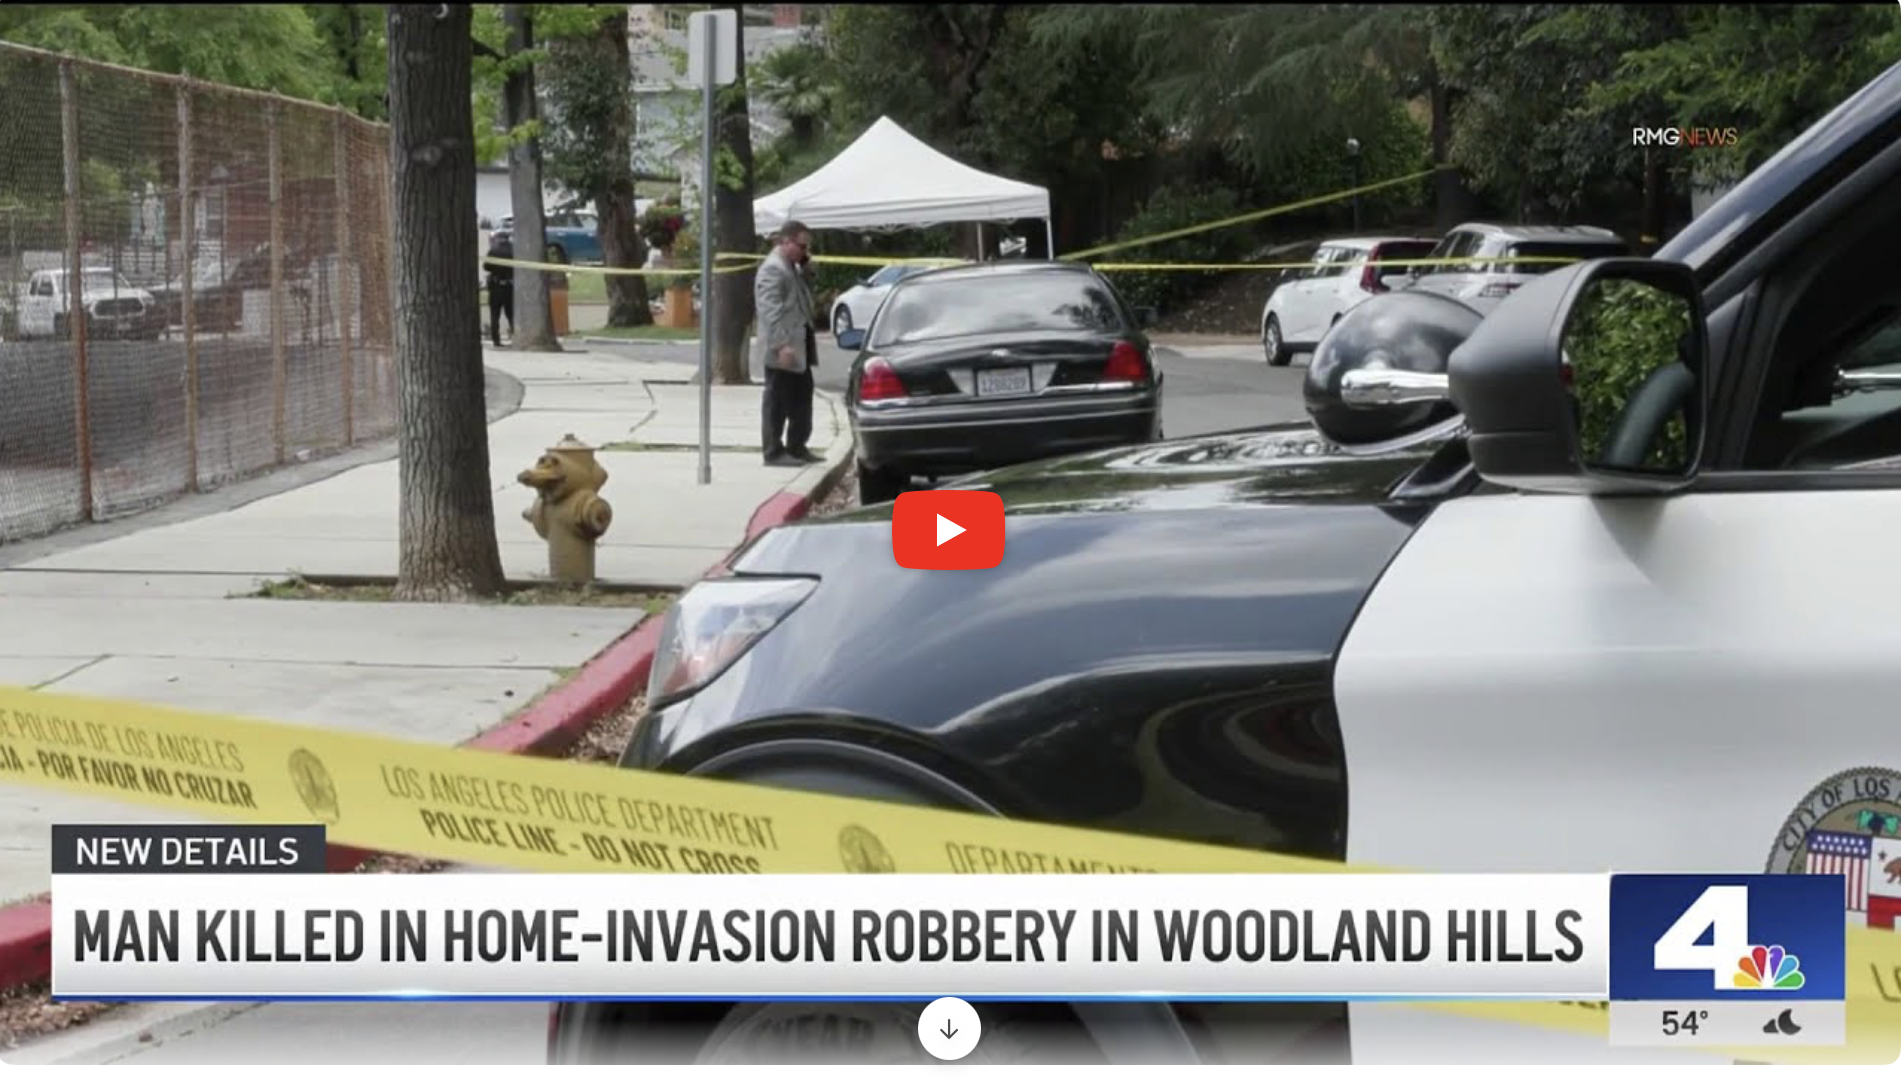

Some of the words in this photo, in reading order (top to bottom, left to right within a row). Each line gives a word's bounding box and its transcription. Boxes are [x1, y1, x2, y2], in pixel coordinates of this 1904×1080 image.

[13, 710, 87, 747] POLICIA
[85, 721, 115, 754] DE
[112, 724, 154, 759] LOS
[155, 731, 245, 773] ANGELES
[36, 749, 79, 781] POR
[77, 754, 143, 792] FAVOR
[141, 764, 173, 797] NO
[172, 771, 258, 810] CRUZAR
[379, 764, 426, 801] LOS
[429, 772, 529, 815] ANGELES
[531, 784, 617, 828] POLICE
[618, 798, 779, 851] DEPARTMENT
[419, 808, 507, 847] POLICE
[504, 821, 568, 857] LINE
[581, 831, 622, 864] DO
[621, 838, 676, 873] NOT
[679, 846, 761, 874] CROSS
[1782, 802, 1816, 851] CITY
[1821, 784, 1843, 809] OF
[1853, 776, 1891, 799] LOS
